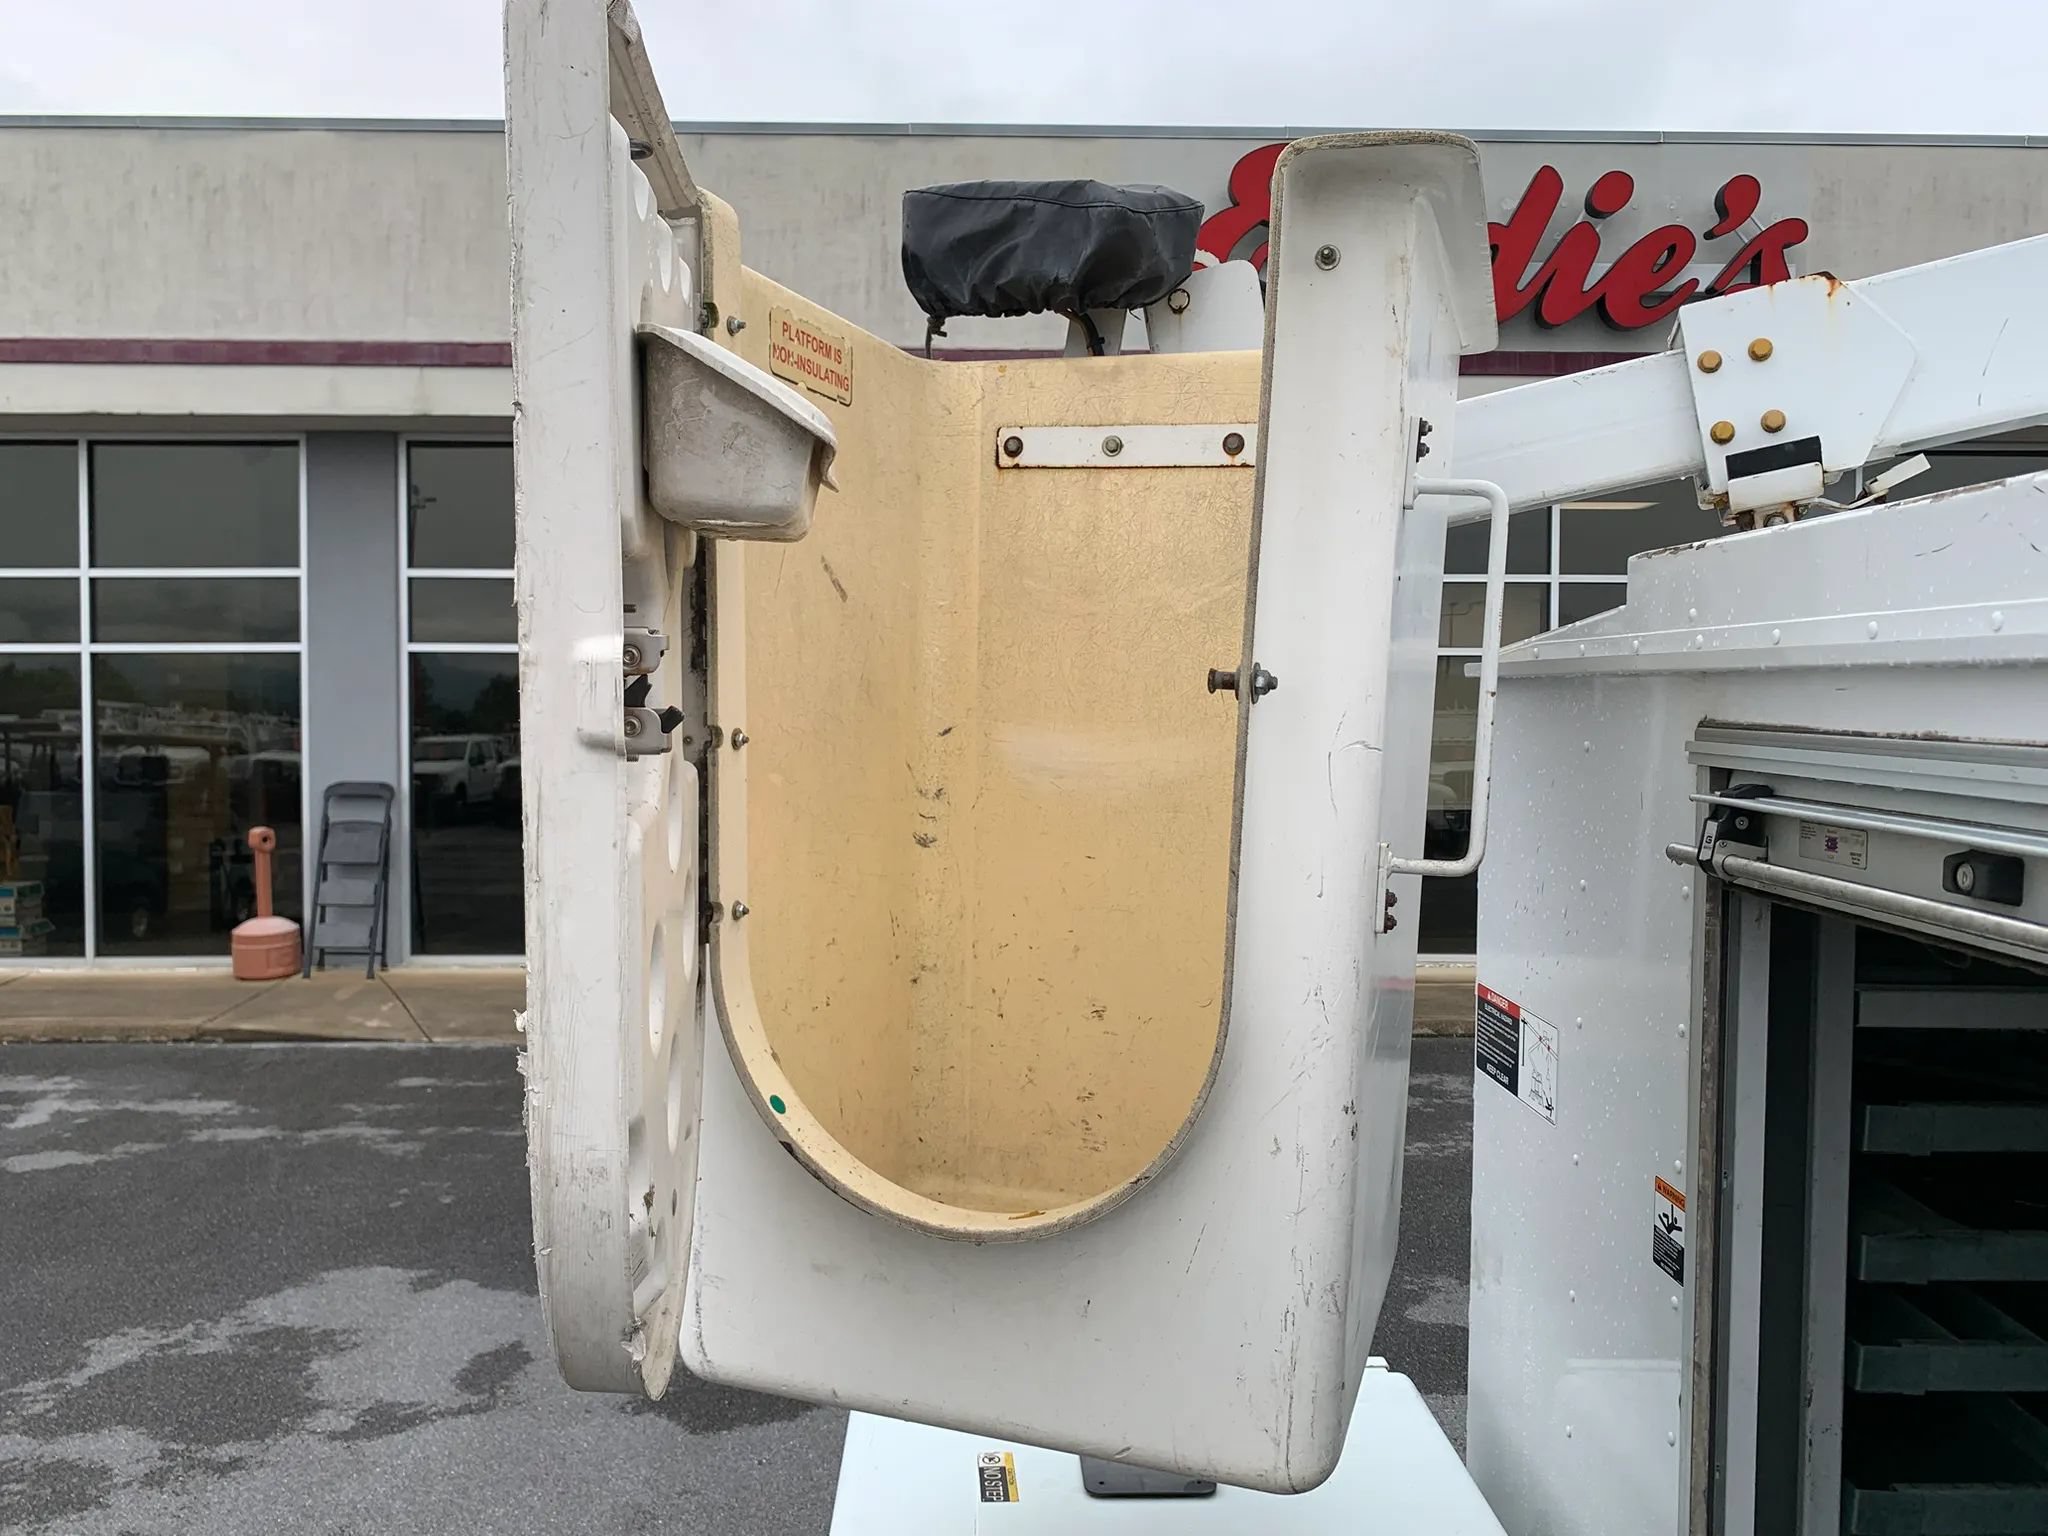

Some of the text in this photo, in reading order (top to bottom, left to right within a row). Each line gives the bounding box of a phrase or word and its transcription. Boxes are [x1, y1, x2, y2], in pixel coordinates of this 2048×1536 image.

[782, 321, 842, 365] PLATFORM IS
[772, 341, 849, 392] NON-INSULATING
[983, 1466, 1004, 1502] NO STEP
